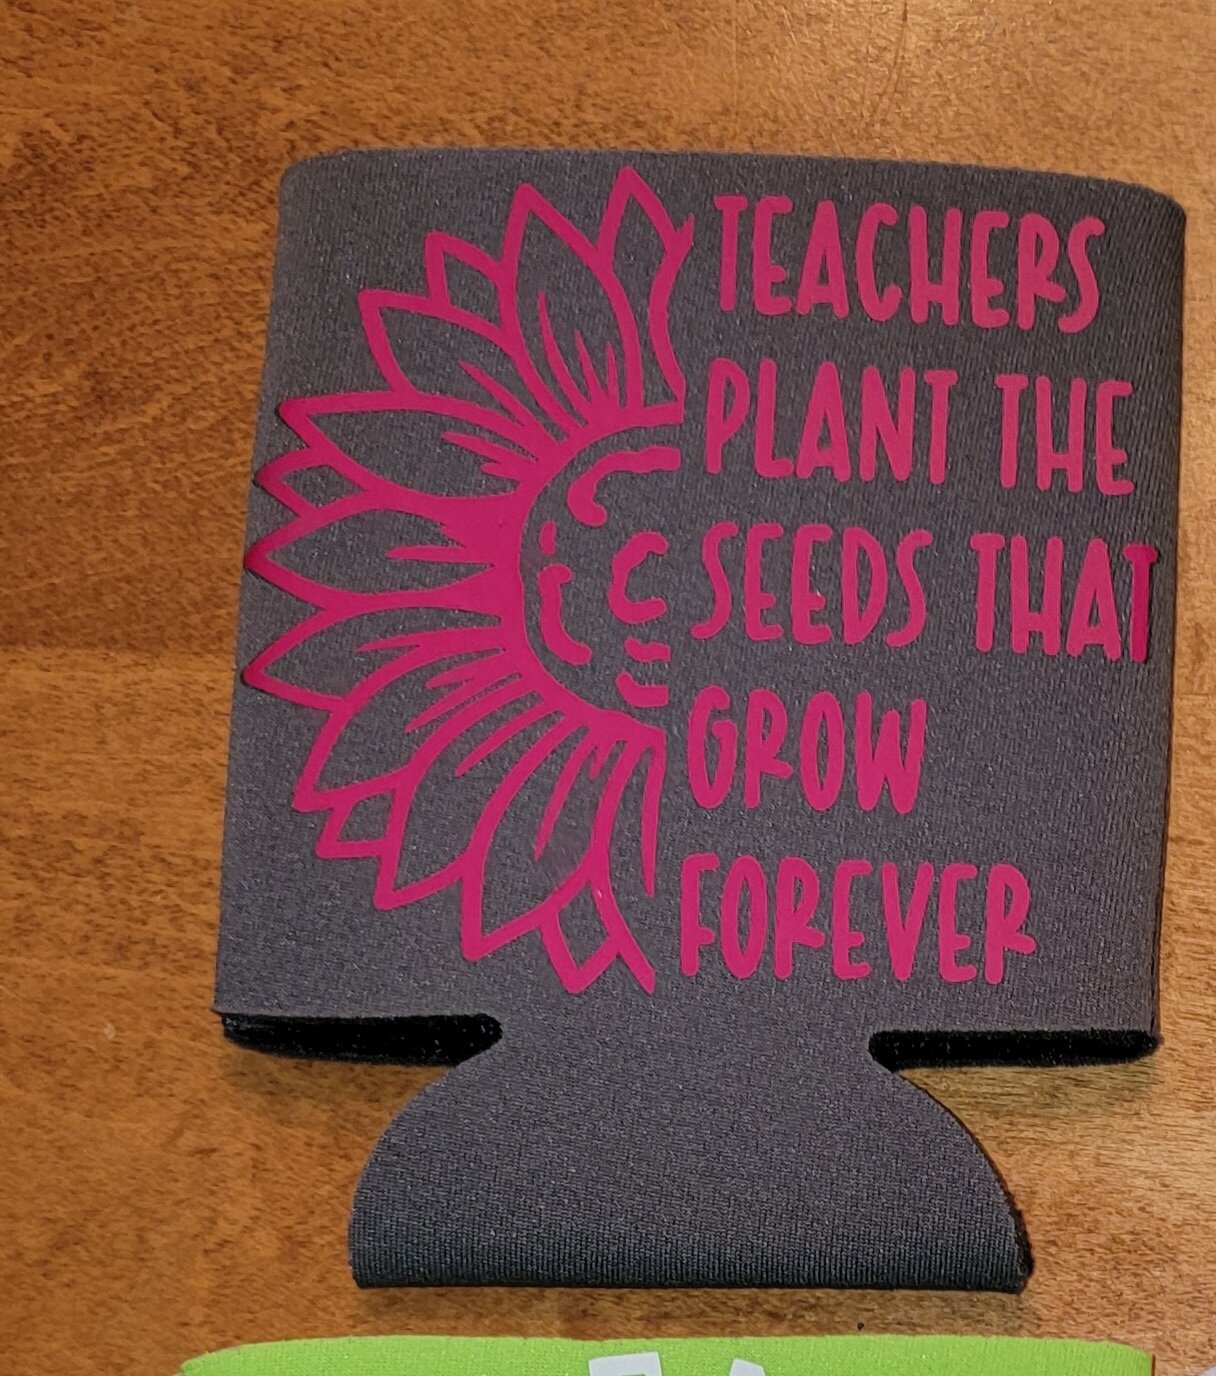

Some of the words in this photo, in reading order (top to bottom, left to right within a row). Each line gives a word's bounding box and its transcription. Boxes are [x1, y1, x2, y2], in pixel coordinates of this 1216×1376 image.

[713, 195, 1106, 333] TEACHERS
[704, 358, 958, 484] PLANT
[997, 374, 1134, 495] THE
[690, 522, 932, 648] SEEDS
[970, 533, 1159, 663] THAT
[687, 688, 928, 814] GROW
[679, 852, 1037, 986] FOREVER
